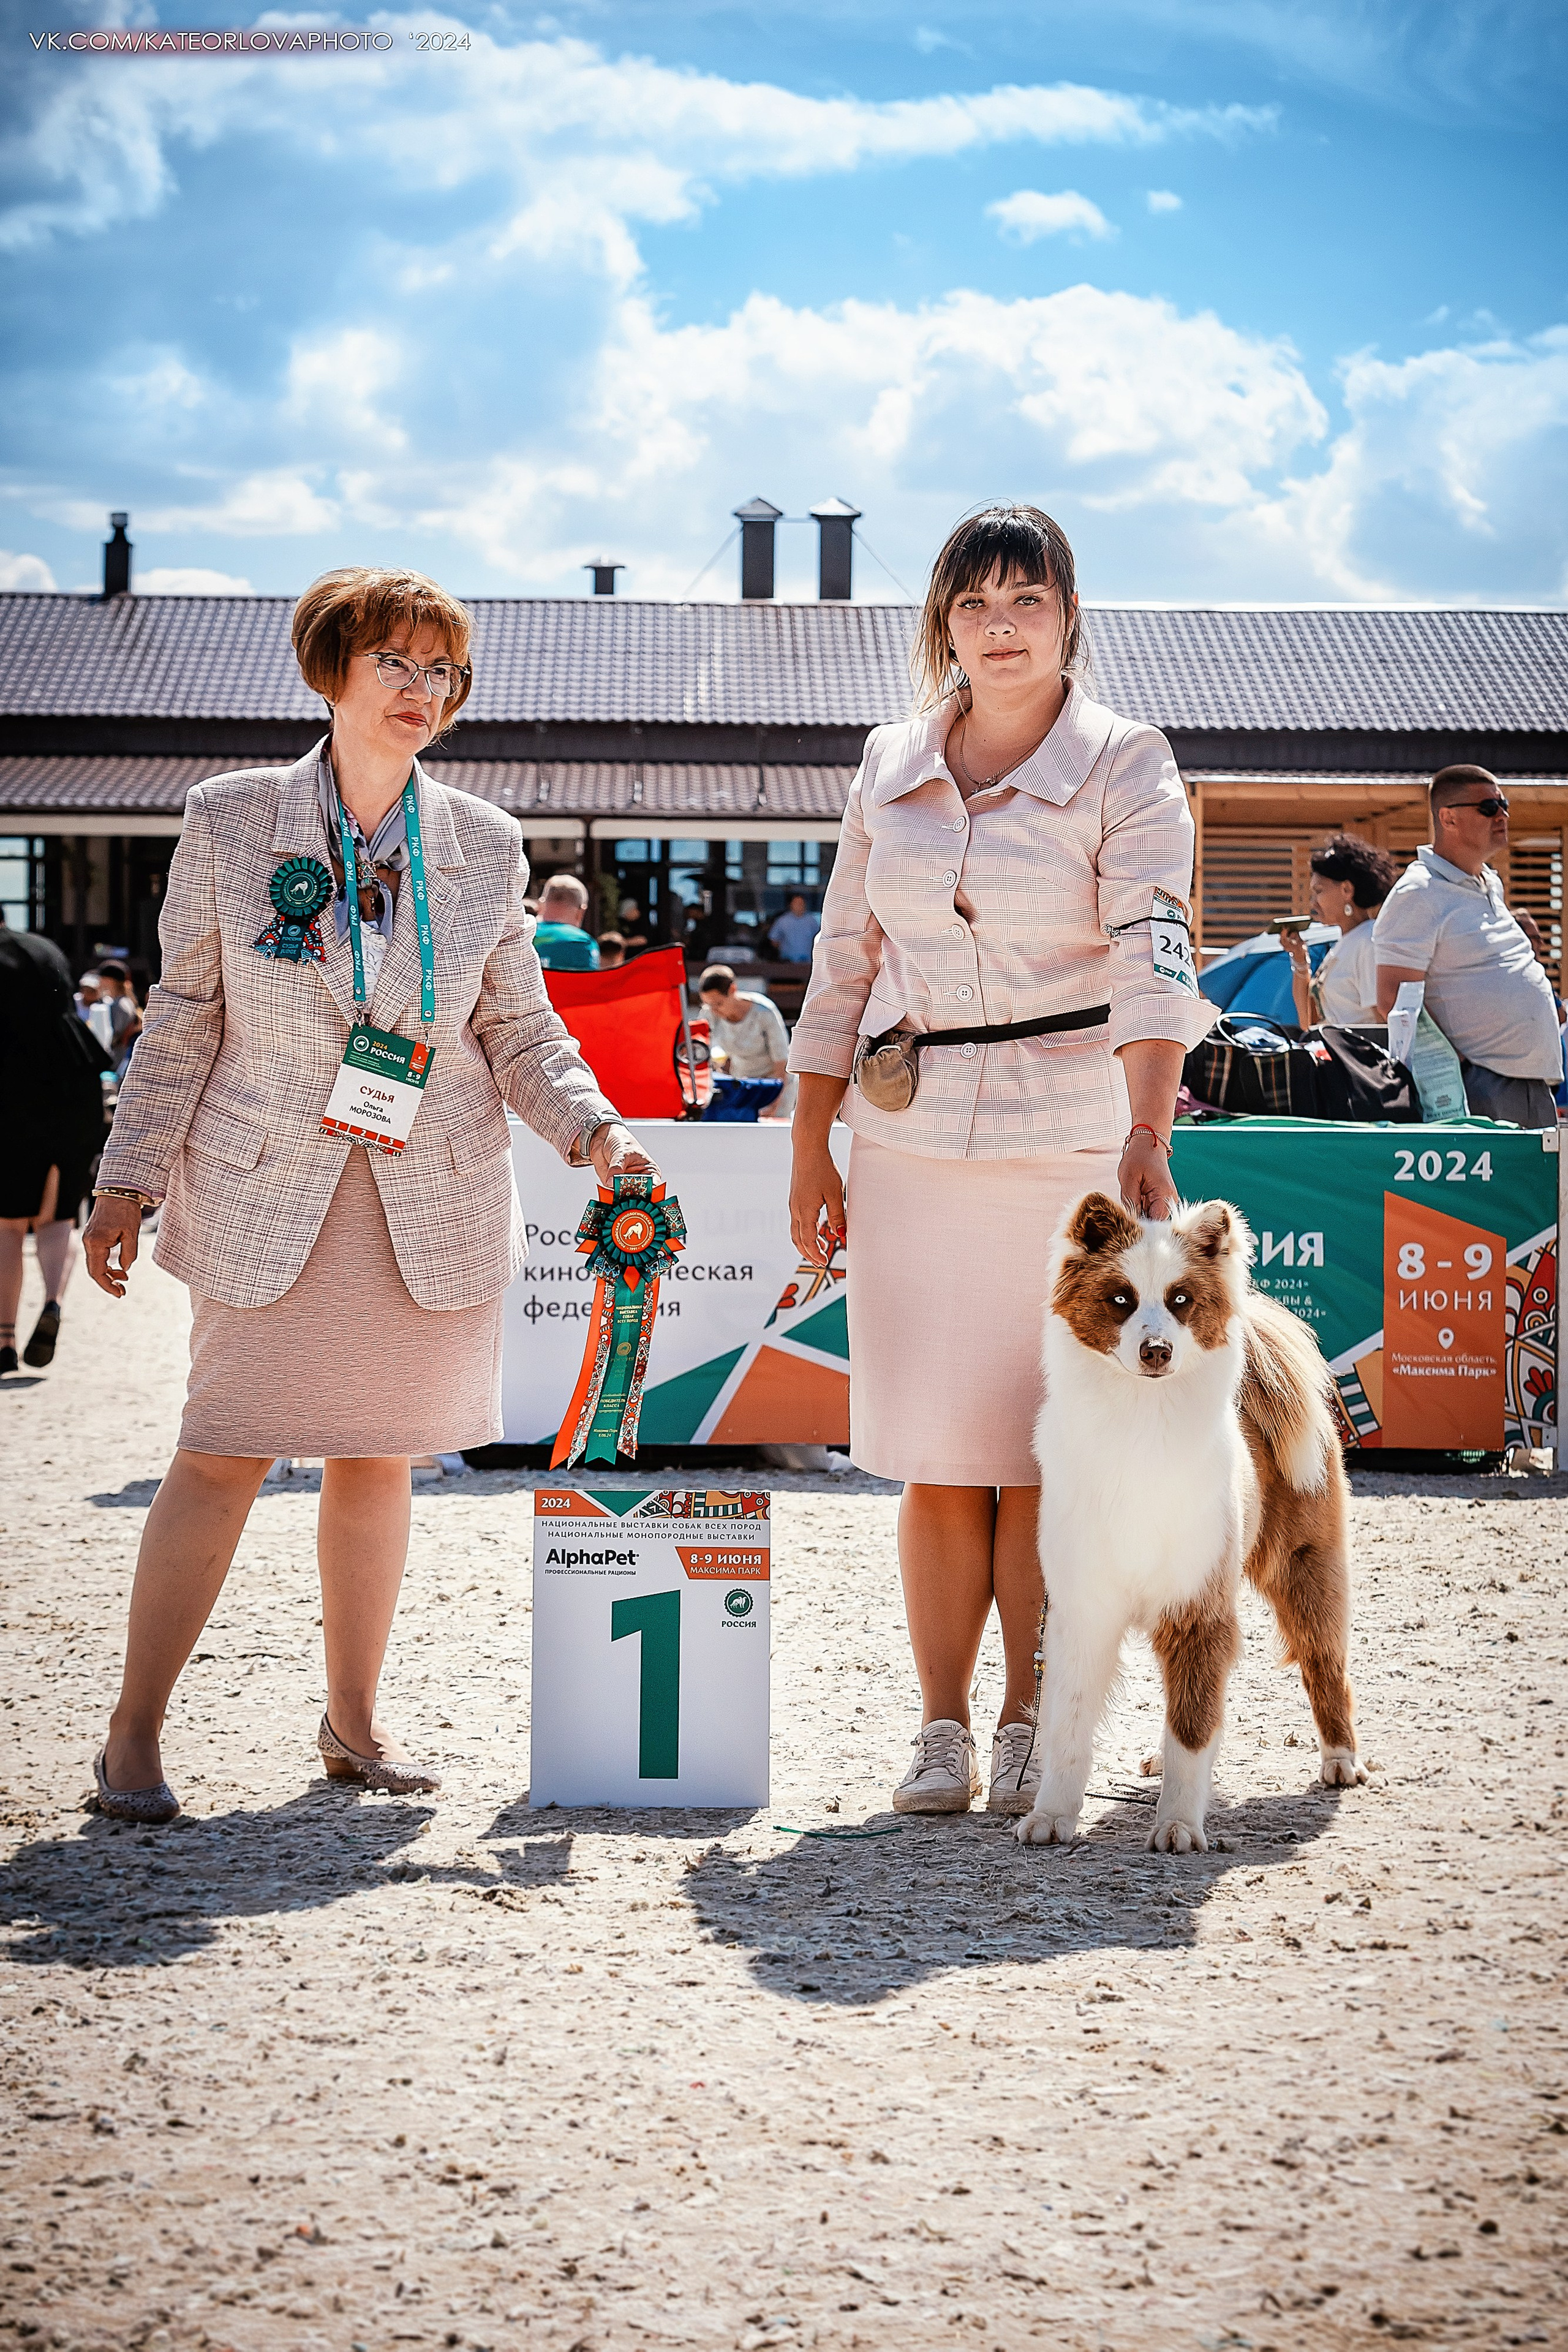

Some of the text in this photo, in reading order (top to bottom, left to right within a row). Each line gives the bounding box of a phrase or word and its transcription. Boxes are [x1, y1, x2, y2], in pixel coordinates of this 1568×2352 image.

[405, 794, 416, 813] РКФ
[342, 817, 350, 837] РКФ
[411, 837, 420, 857] РКФ
[345, 861, 354, 881] РКФ
[416, 880, 424, 901] РКФ
[420, 924, 430, 945] РКФ
[372, 1041, 388, 1050] 2024
[370, 1047, 407, 1065] РОССИЯ
[360, 1085, 396, 1104] СУДЬЯ
[349, 1105, 392, 1125] МОРОЗОВА
[363, 1101, 384, 1113] Ольга
[1393, 1150, 1493, 1182] 2024
[1399, 1289, 1492, 1311] ИЮНЯ
[1392, 1352, 1452, 1363] Московская
[1392, 1363, 1496, 1379] «Максима Парк»
[541, 1498, 571, 1509] 2024
[545, 1548, 637, 1569] AlphaPet
[690, 1553, 761, 1565] 8-9 ИЮНЯ
[611, 1589, 682, 1780] 1
